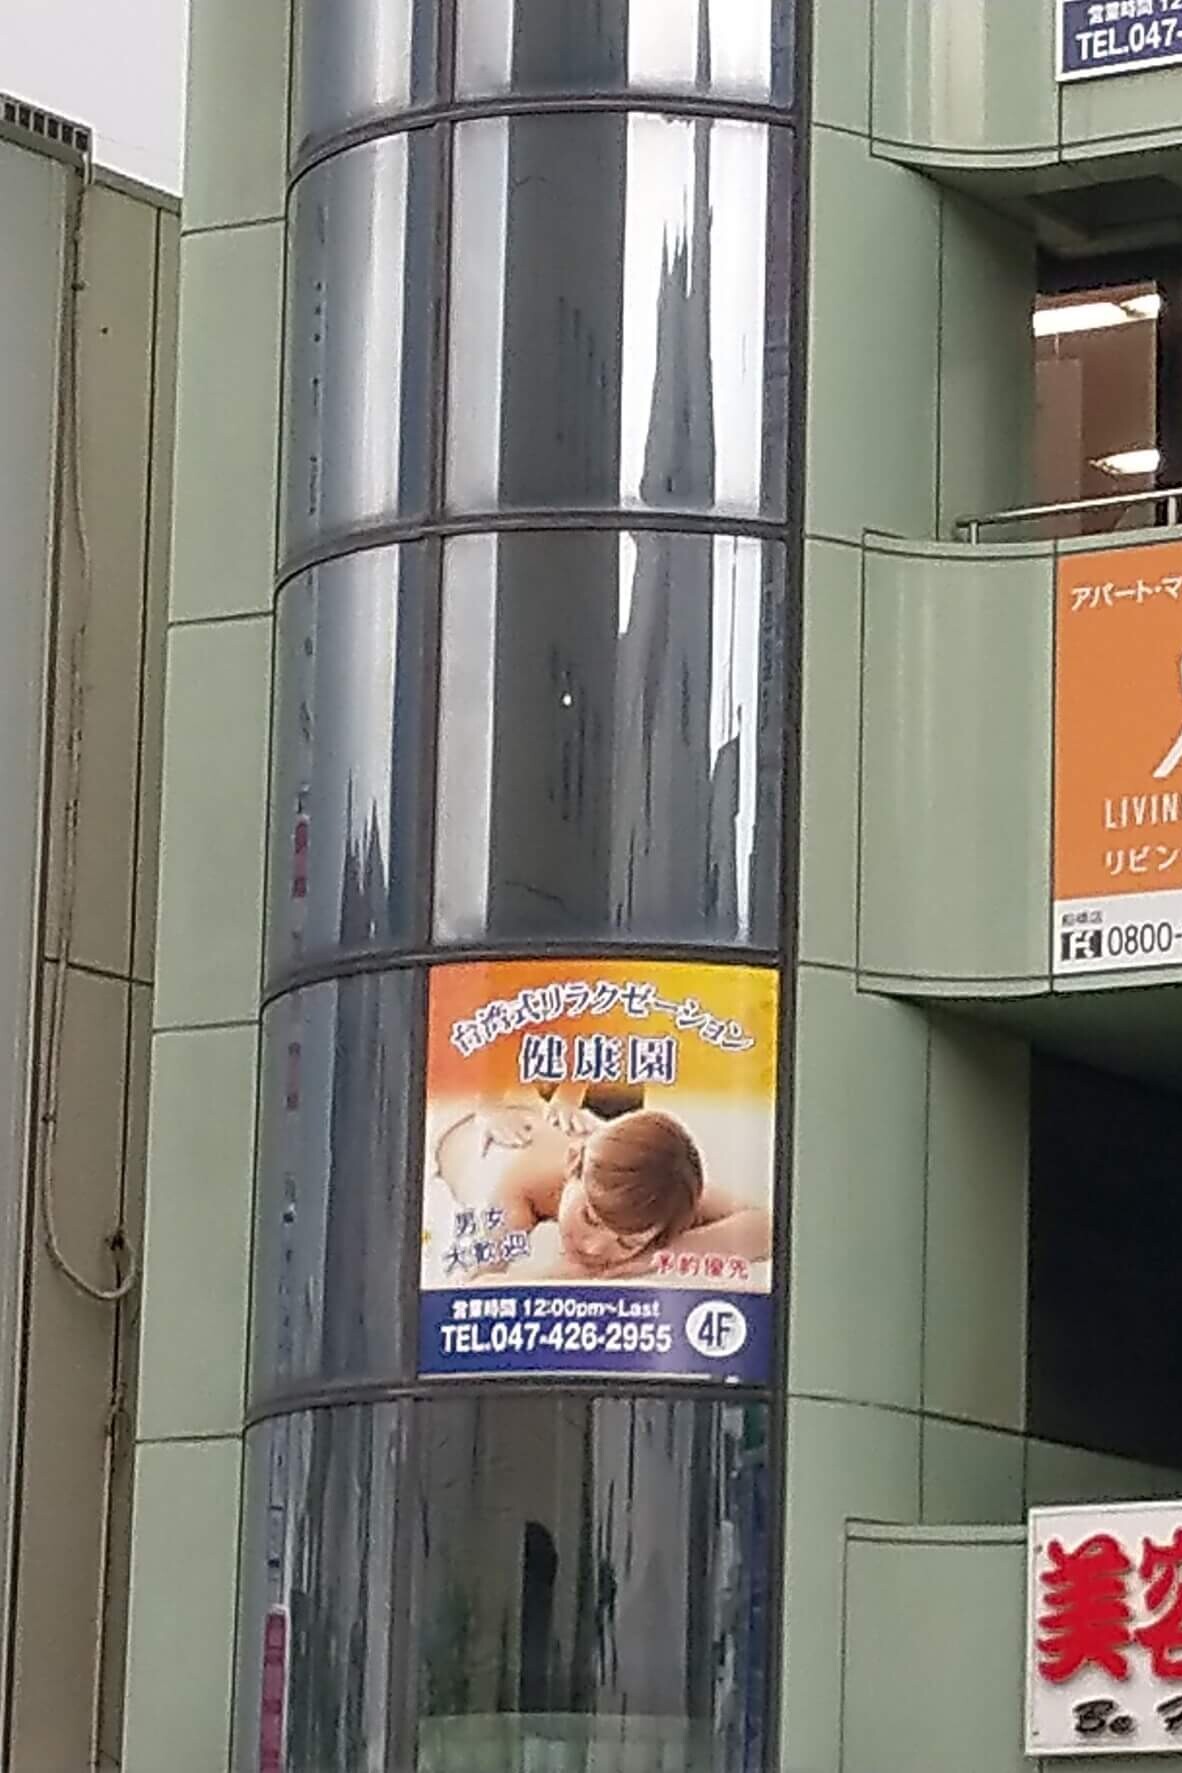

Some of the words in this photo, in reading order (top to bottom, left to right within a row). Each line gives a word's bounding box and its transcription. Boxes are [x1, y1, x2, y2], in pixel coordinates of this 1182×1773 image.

[520, 1034, 677, 1082] 健康園
[455, 1207, 503, 1237] 男女
[441, 1323, 672, 1353] TEL.047-426-2955
[699, 1310, 734, 1348] 4F
